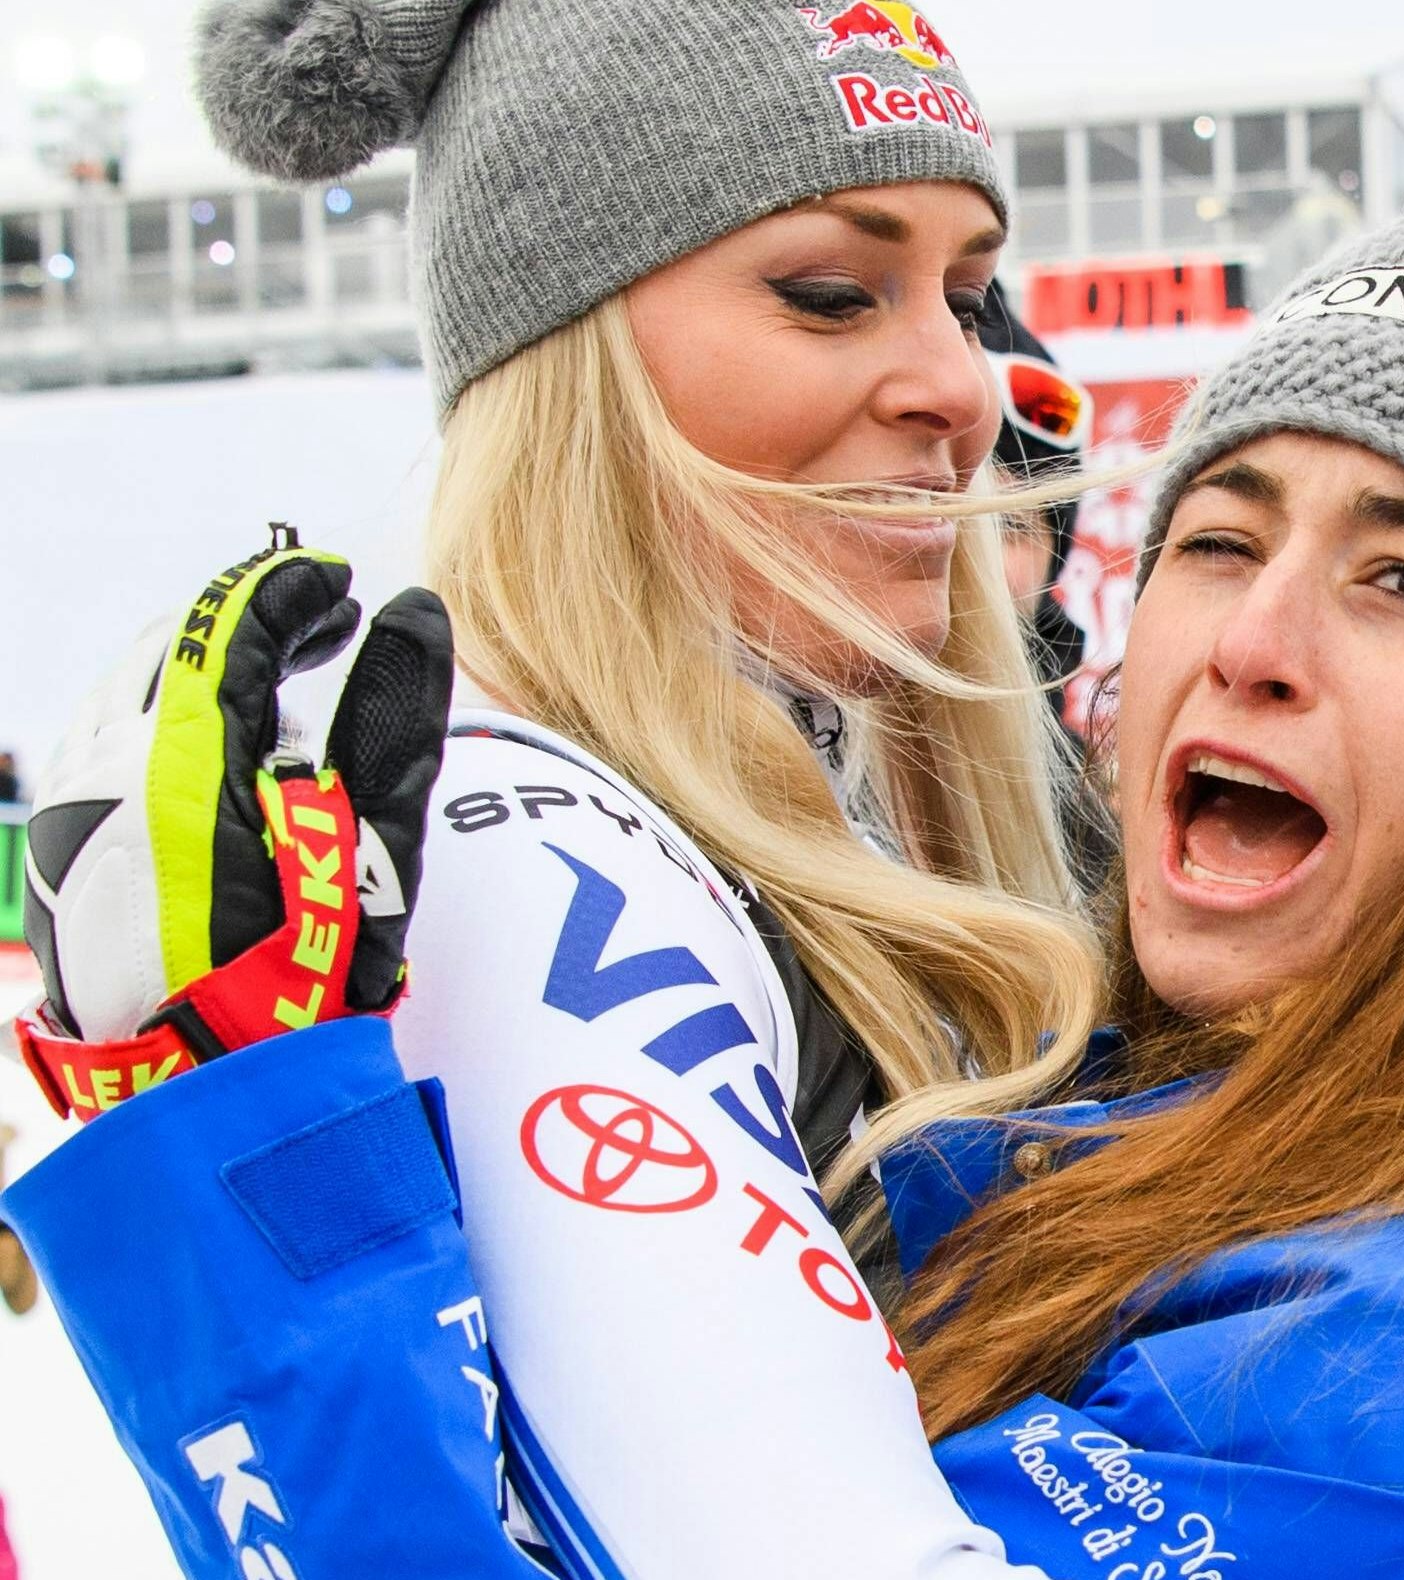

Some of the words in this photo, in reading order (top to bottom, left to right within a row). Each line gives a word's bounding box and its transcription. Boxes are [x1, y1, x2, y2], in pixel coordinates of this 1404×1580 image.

[837, 75, 951, 127] Red
[272, 804, 344, 1031] LEKI
[540, 840, 833, 1226] VIS
[1002, 1413, 1104, 1527] Maestri
[1082, 1523, 1138, 1562] di
